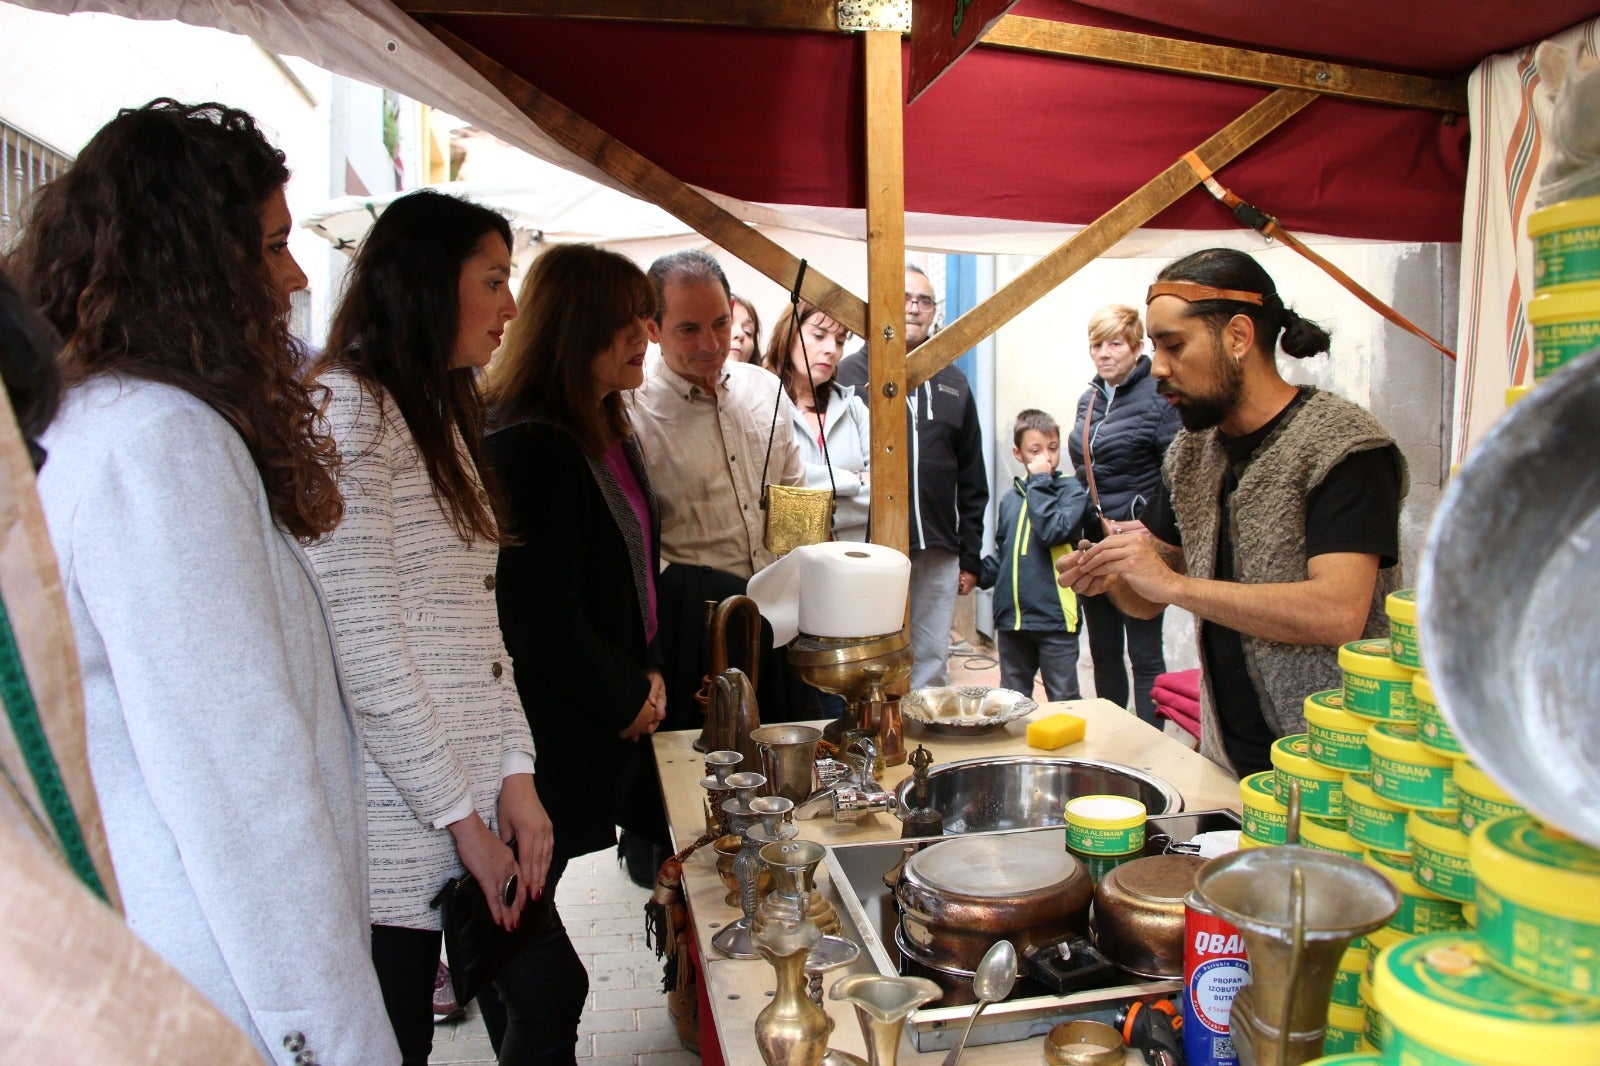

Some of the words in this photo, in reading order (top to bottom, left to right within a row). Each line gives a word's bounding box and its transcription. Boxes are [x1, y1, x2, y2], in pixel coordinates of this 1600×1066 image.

[1381, 759, 1432, 778] ALEMANA
[1280, 771, 1320, 790] ALEANA
[1254, 811, 1288, 823] ALEMAN
[1203, 961, 1230, 971] Portable
